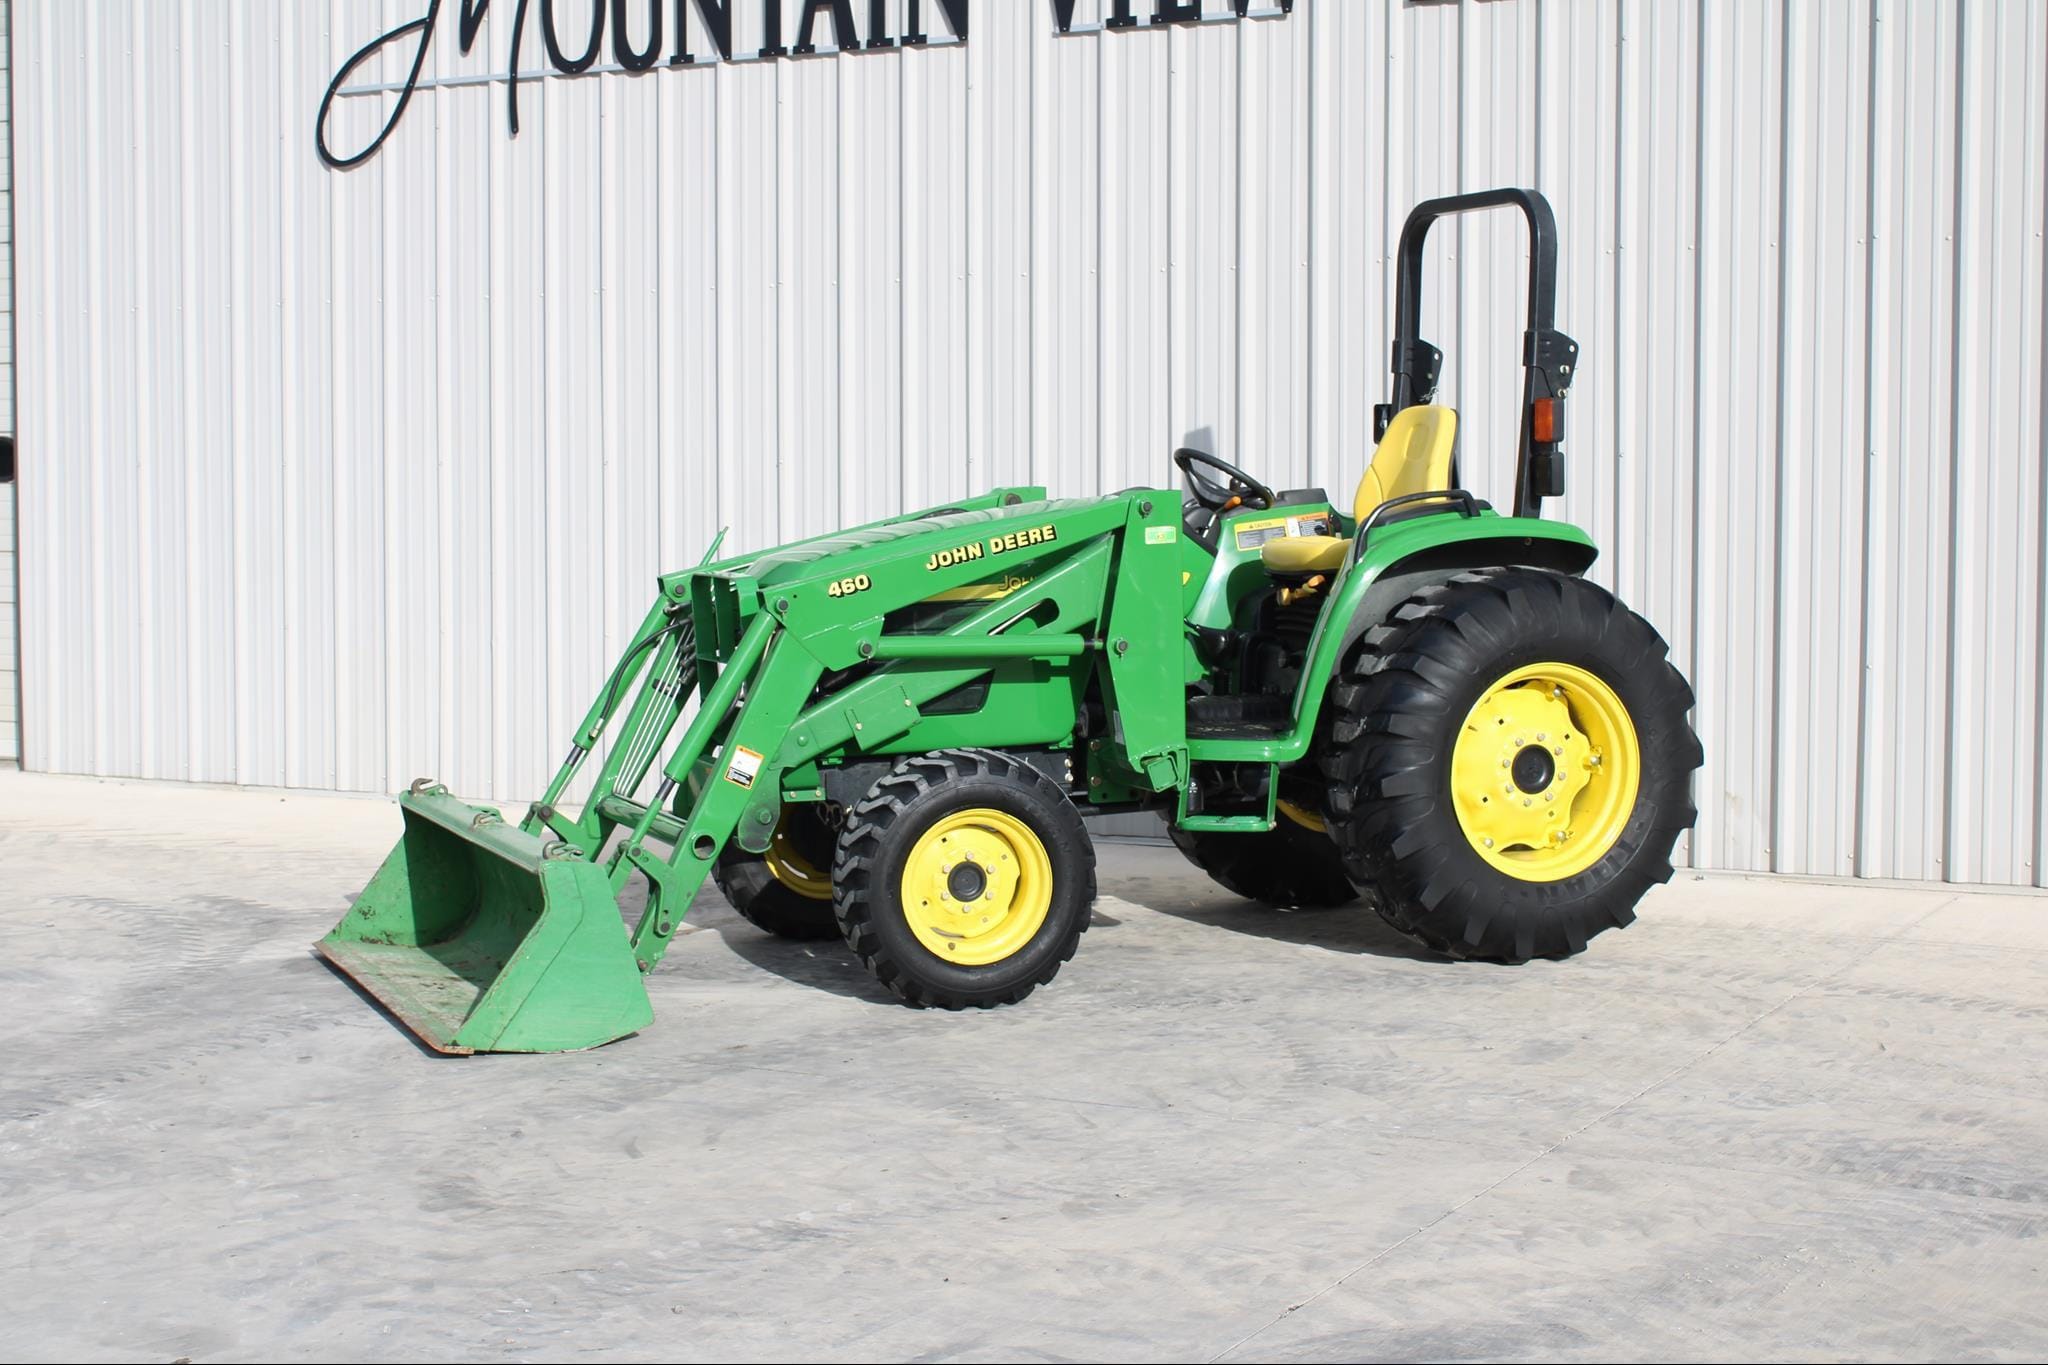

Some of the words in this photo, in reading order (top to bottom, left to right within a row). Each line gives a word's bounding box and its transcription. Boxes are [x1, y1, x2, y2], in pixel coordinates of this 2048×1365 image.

[926, 542, 984, 571] JOHN
[990, 525, 1057, 556] DEERE
[828, 575, 871, 598] 460
[998, 575, 1038, 591] JO
